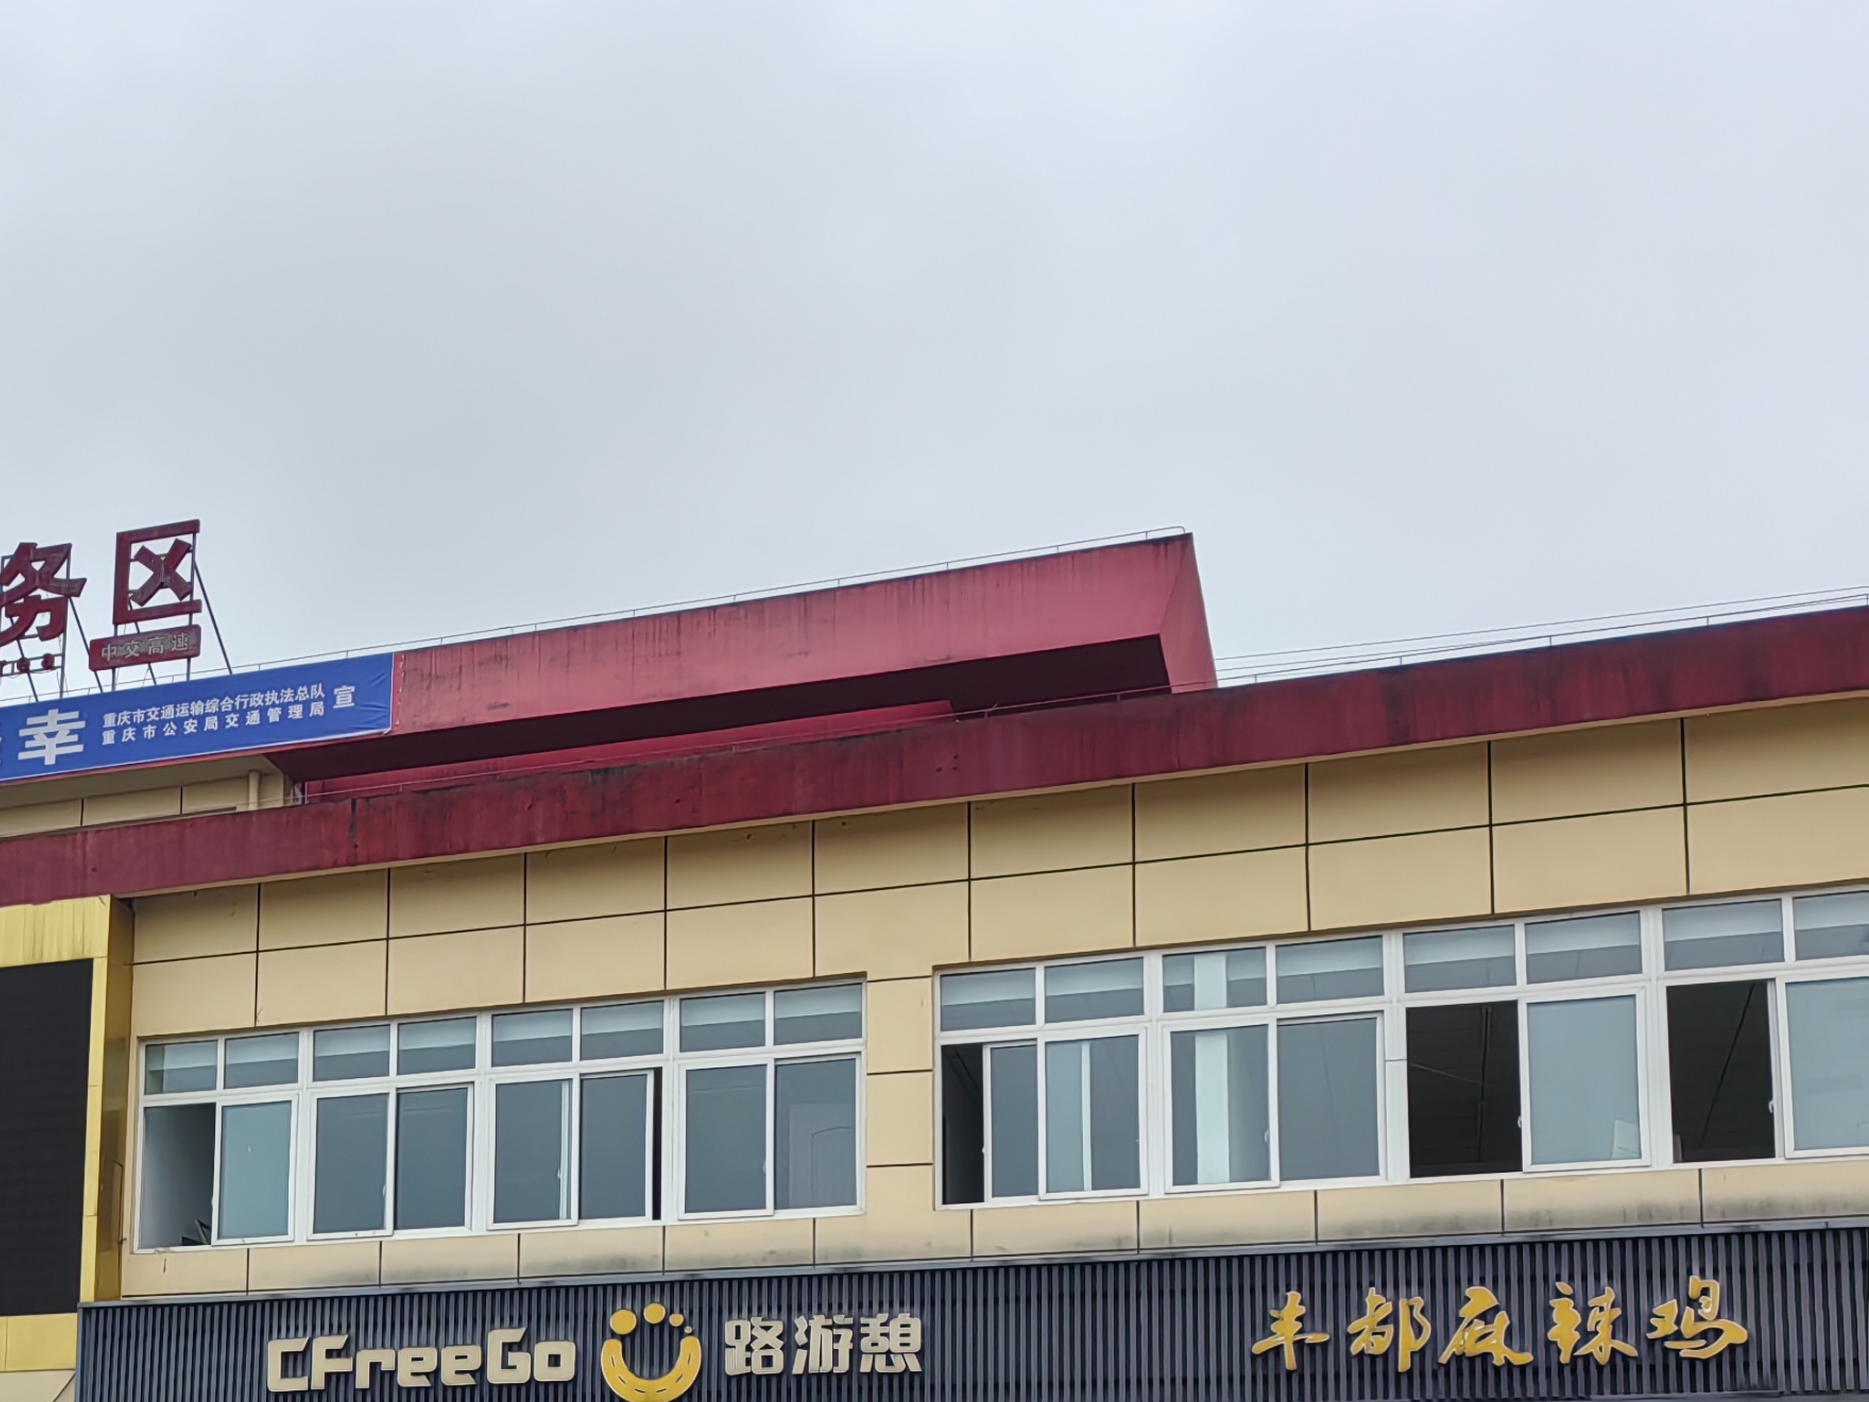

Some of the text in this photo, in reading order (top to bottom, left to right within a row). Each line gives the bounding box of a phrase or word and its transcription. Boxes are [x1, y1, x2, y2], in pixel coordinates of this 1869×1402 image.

[101, 633, 190, 662] 中交高速
[101, 702, 325, 746] 重庆市公安局交通管理局
[102, 683, 356, 728] 重庆市交通运输综合行政执法总队 宣
[724, 1311, 924, 1376] 路游憩
[1250, 1274, 1749, 1374] 丰都麻辣鸡
[266, 1327, 577, 1392] CFreeGo
